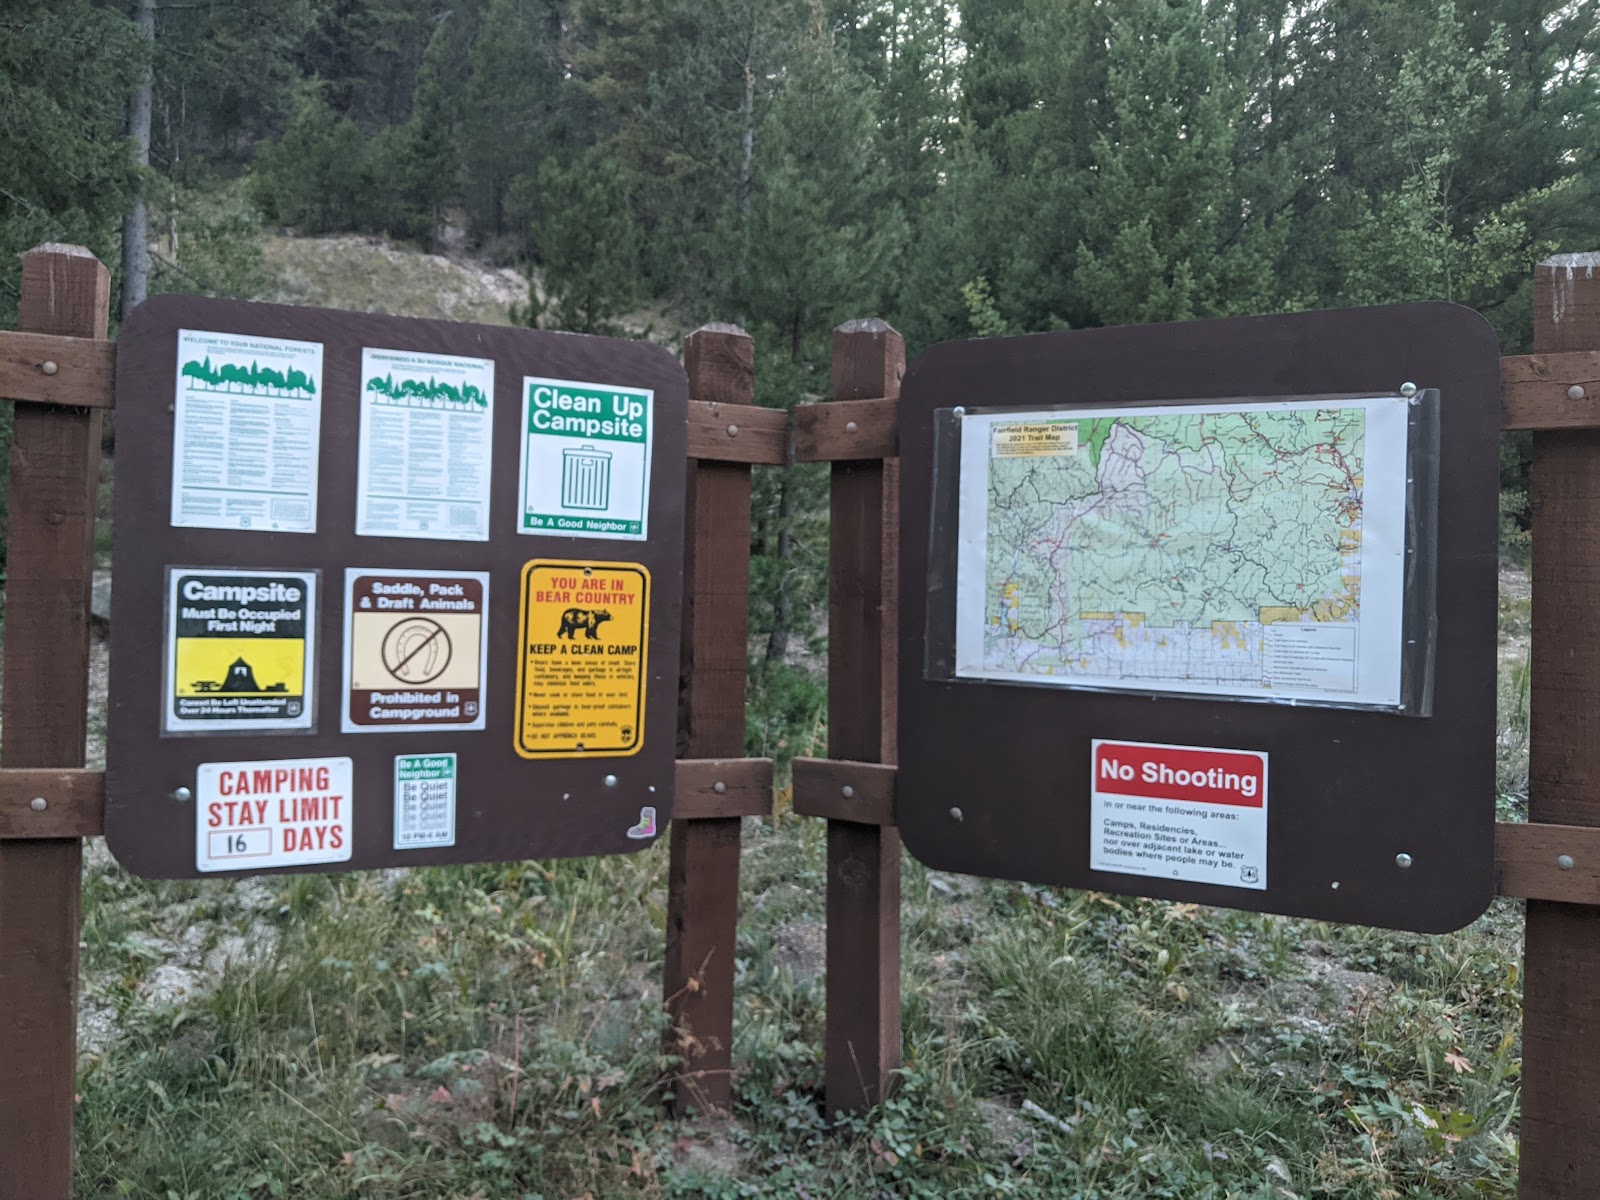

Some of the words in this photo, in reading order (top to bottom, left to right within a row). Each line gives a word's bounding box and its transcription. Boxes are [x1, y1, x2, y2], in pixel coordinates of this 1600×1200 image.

[184, 337, 218, 345] WELCOME
[250, 342, 282, 350] NATIONAL
[533, 387, 601, 413] Clean
[613, 395, 644, 420] Up
[533, 410, 643, 438] Campsite
[530, 516, 543, 526] Be
[547, 518, 554, 526] A
[558, 518, 583, 528] Good
[586, 520, 627, 531] Neighbor
[372, 582, 424, 596] Saddle,
[429, 584, 464, 596] Pack
[551, 577, 576, 589] YOU
[582, 579, 606, 590] ARE
[611, 580, 624, 590] IN
[183, 581, 301, 605] Campsite
[536, 592, 570, 603] BEAR
[576, 592, 635, 605] COUNTRY
[360, 597, 371, 608] &
[377, 597, 414, 609] Draft
[420, 598, 475, 610] Animals
[182, 608, 216, 619] Must
[218, 608, 236, 619] Be
[238, 608, 301, 621] Occupied
[208, 620, 238, 631] First
[240, 621, 276, 634] Night
[530, 644, 556, 654] KEEP
[561, 645, 567, 654] A
[571, 645, 604, 655] CLEAN
[608, 645, 637, 655] CAMP
[370, 692, 441, 703] Prohibited
[446, 693, 459, 703] in
[369, 706, 459, 720] Campground
[400, 760, 412, 768] Be
[424, 759, 448, 767] Good
[400, 770, 440, 778] Neighbor
[1101, 758, 1134, 780] No
[1141, 761, 1257, 797] Shooting
[219, 767, 329, 796] CAMPING
[421, 782, 447, 790] Quiet
[420, 791, 447, 801] Quiet
[208, 800, 268, 828] STAY
[279, 796, 343, 823] LIMIT
[1148, 804, 1162, 812] the
[1165, 806, 1208, 818] following
[1210, 808, 1239, 820] areas:
[1104, 818, 1136, 830] Camps,
[227, 834, 247, 854] 16
[283, 825, 343, 852] DAYS
[1104, 828, 1151, 840] Recreation
[1154, 833, 1176, 843] Sites
[1104, 847, 1133, 857] bodies
[1136, 850, 1162, 860] where
[1166, 854, 1196, 864] people
[1199, 858, 1218, 868] may
[1143, 842, 1181, 854] adjacent
[1184, 846, 1202, 855] lake
[1218, 850, 1244, 860] water
